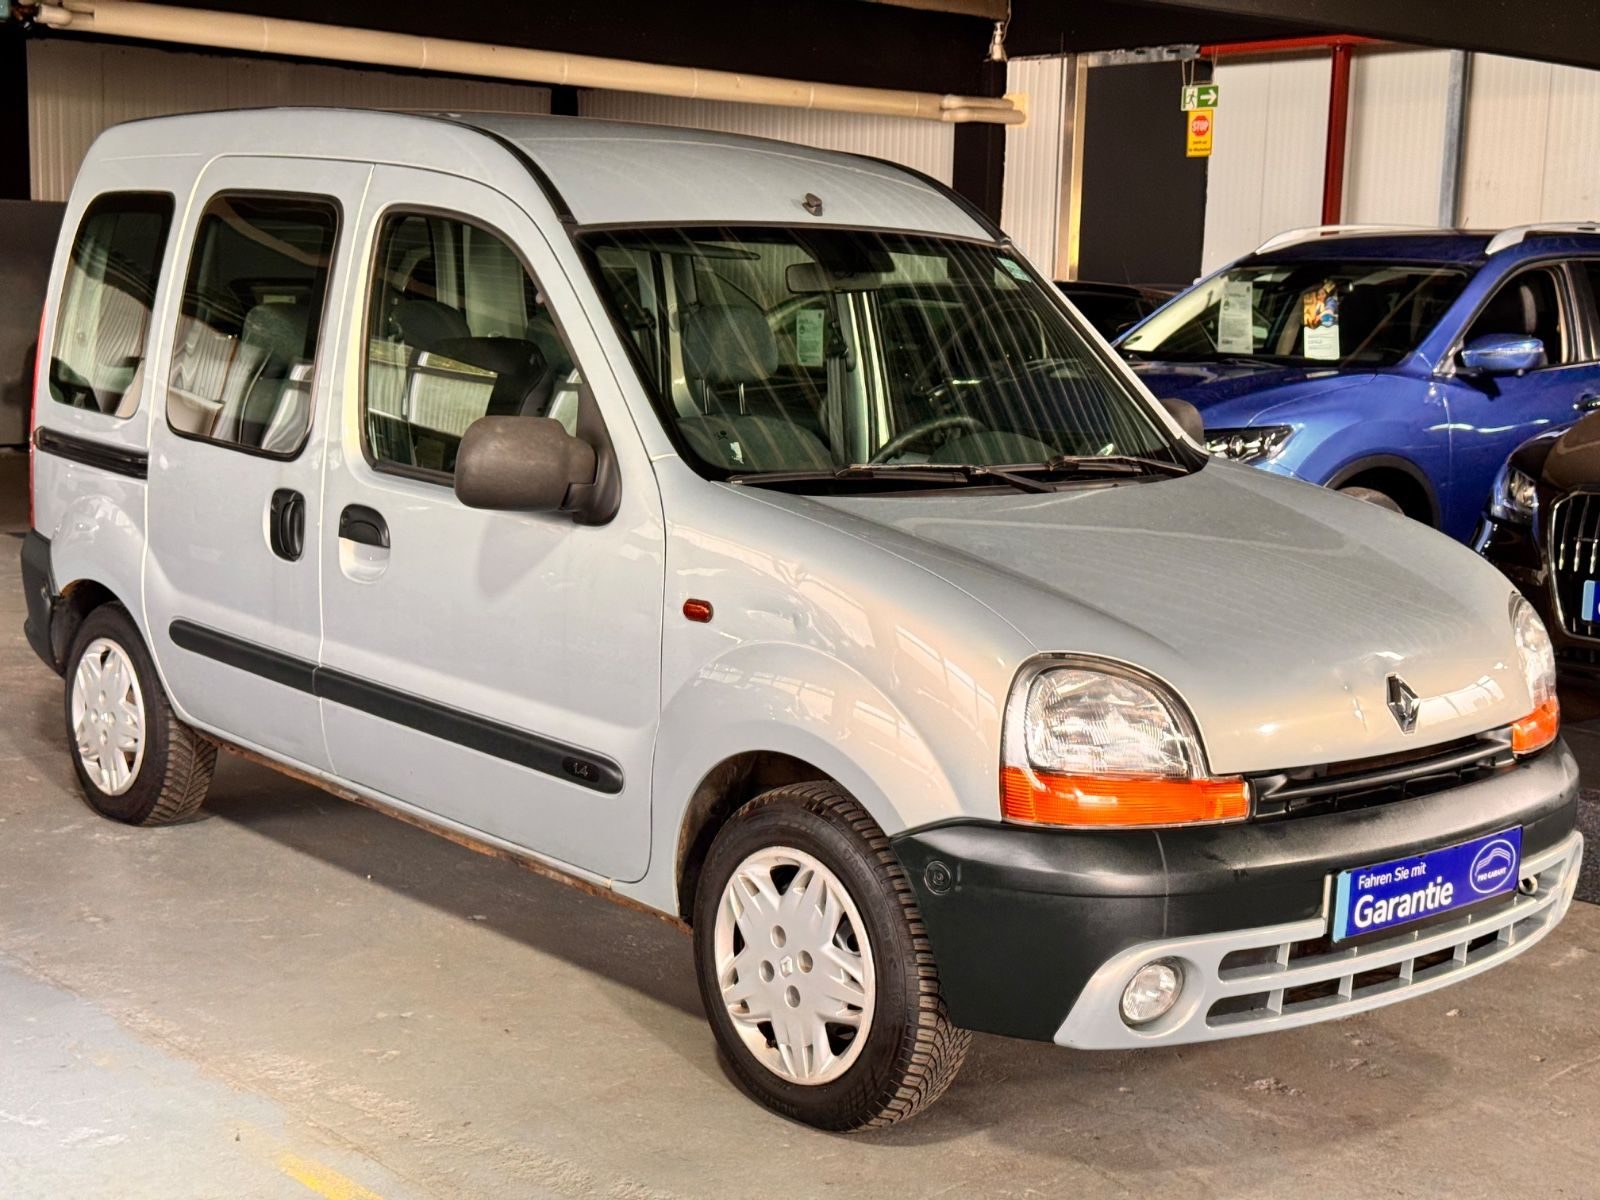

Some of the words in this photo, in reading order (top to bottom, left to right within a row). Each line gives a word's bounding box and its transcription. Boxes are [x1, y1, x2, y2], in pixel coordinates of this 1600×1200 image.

[1192, 119, 1209, 133] STOP
[1358, 873, 1392, 890] Fahren
[1394, 866, 1409, 882] Sie
[1411, 861, 1427, 878] mit
[1354, 876, 1454, 928] Garantie
